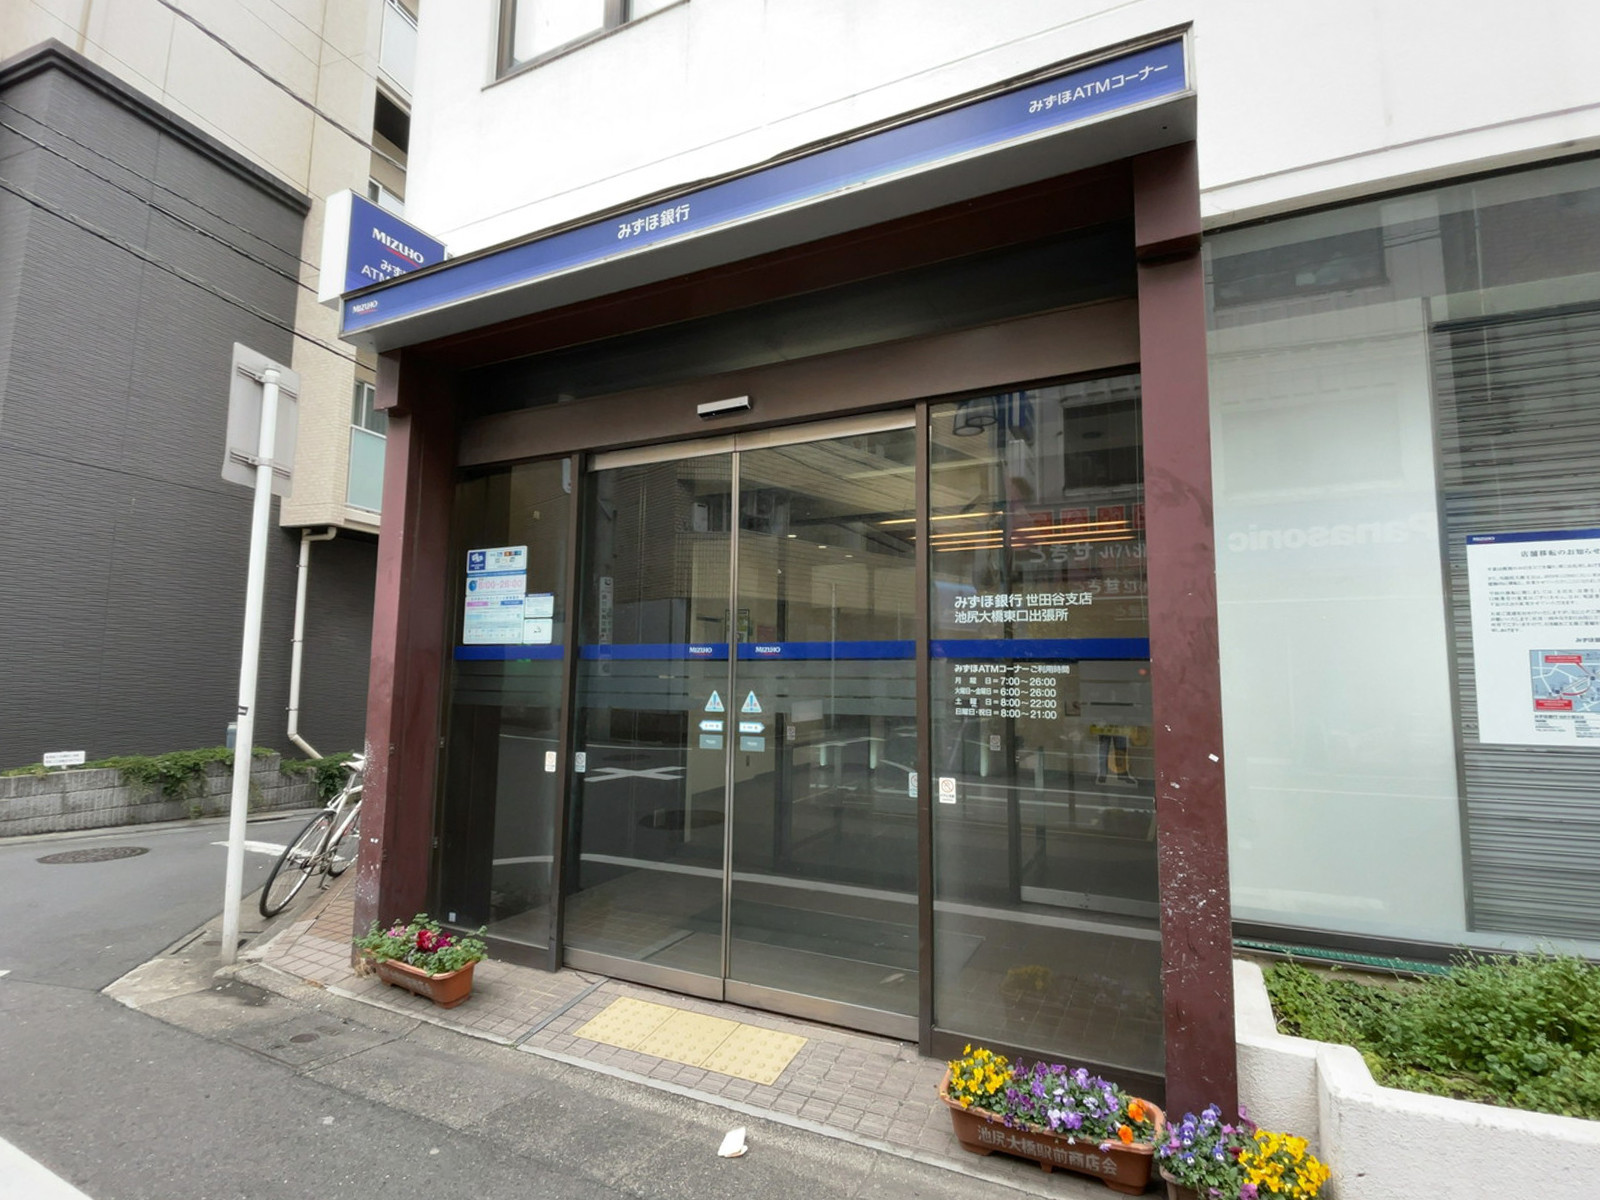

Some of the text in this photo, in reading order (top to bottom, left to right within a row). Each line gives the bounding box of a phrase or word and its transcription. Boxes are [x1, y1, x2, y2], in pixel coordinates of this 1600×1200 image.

[1028, 65, 1168, 113] みずほATMコーナー
[617, 203, 690, 239] みずほ銀行
[372, 227, 424, 263] MIZUHO
[380, 259, 407, 277] みず
[352, 300, 378, 314] MIZUHO
[954, 592, 1093, 608] みずほ銀行 世田谷支店
[954, 608, 1069, 623] 池尻大橋東口出張所
